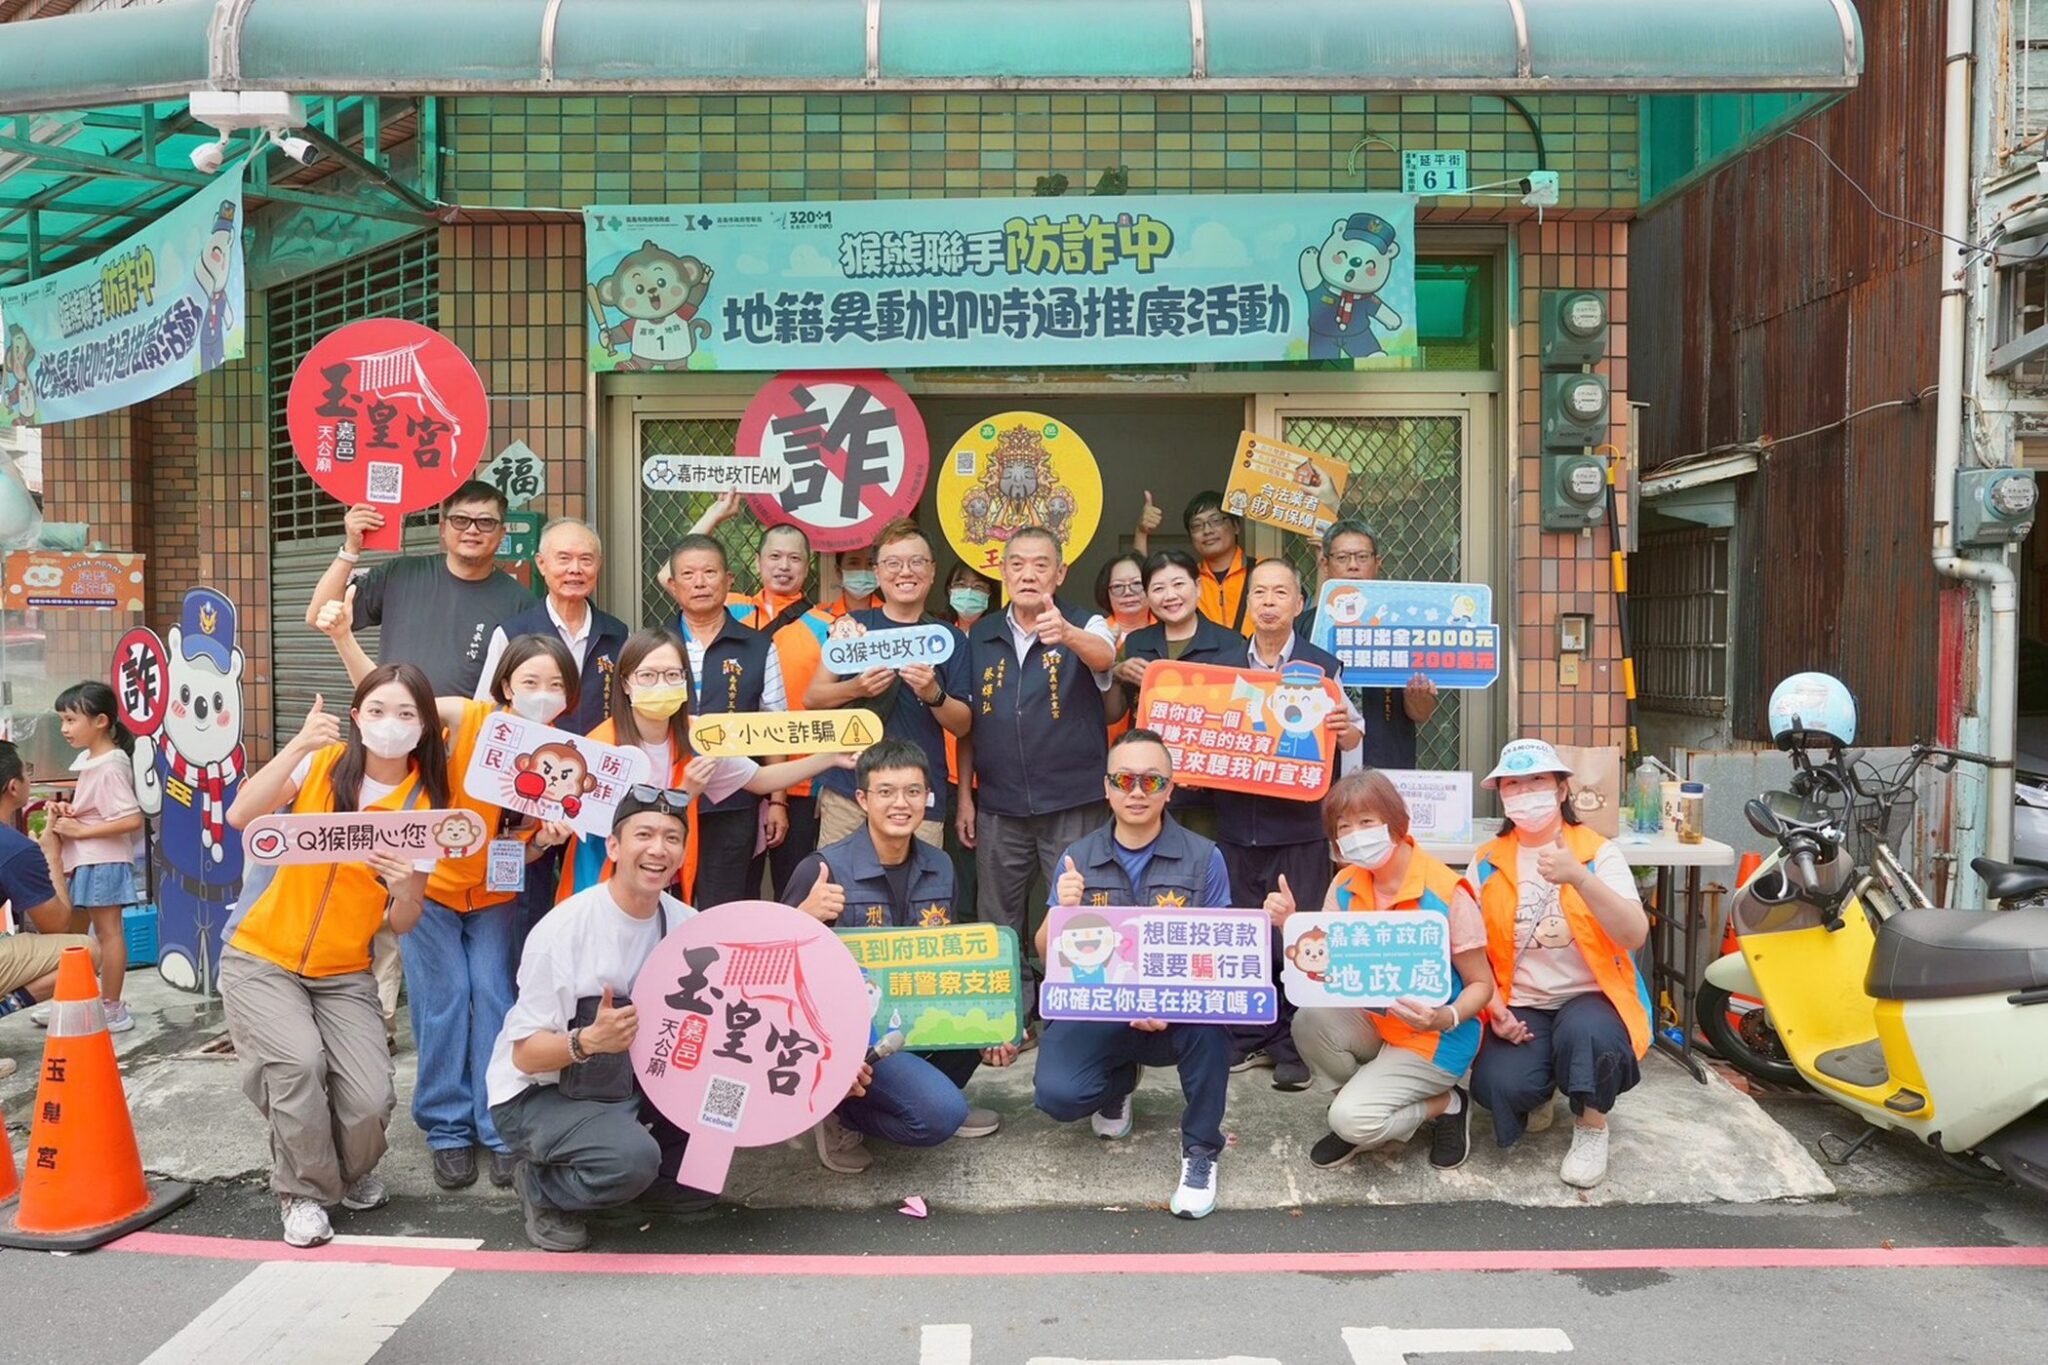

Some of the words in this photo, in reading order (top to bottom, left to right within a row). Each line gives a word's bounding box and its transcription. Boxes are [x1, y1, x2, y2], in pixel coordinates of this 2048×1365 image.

[1420, 154, 1460, 166] 延平街
[1424, 170, 1457, 189] 61
[840, 214, 1174, 278] 猴熊聯手防詐中
[723, 283, 1291, 344] 地籍異動即時通推廣活動
[315, 363, 451, 469] 玉皇宮
[315, 425, 334, 473] 天公廟
[335, 420, 356, 461] 嘉邑
[771, 384, 898, 520] 詐
[492, 456, 538, 498] 福
[677, 464, 781, 485] 嘉市地政TEAM
[1261, 483, 1320, 513] 合法業者
[829, 635, 926, 664] Q猴地政了
[122, 645, 158, 716] 詐
[739, 720, 836, 745] 小心詐騙
[1150, 701, 1242, 729] 跟你說一個
[485, 722, 512, 769] 全民
[593, 755, 621, 801] 防詐
[297, 822, 427, 852] Q猴關心您
[866, 905, 883, 928] 刑
[1143, 921, 1258, 947] 想匯投資款
[1330, 924, 1441, 948] 嘉義市政府
[888, 969, 1012, 997] 請警察支援
[1142, 952, 1263, 980] 還要騙行員
[1330, 958, 1444, 994] 地政處
[664, 946, 820, 1097] 玉皇宮
[645, 1018, 680, 1079] 天公廟
[673, 1016, 708, 1069] 嘉邑
[37, 1057, 67, 1169] 玉皇宮
